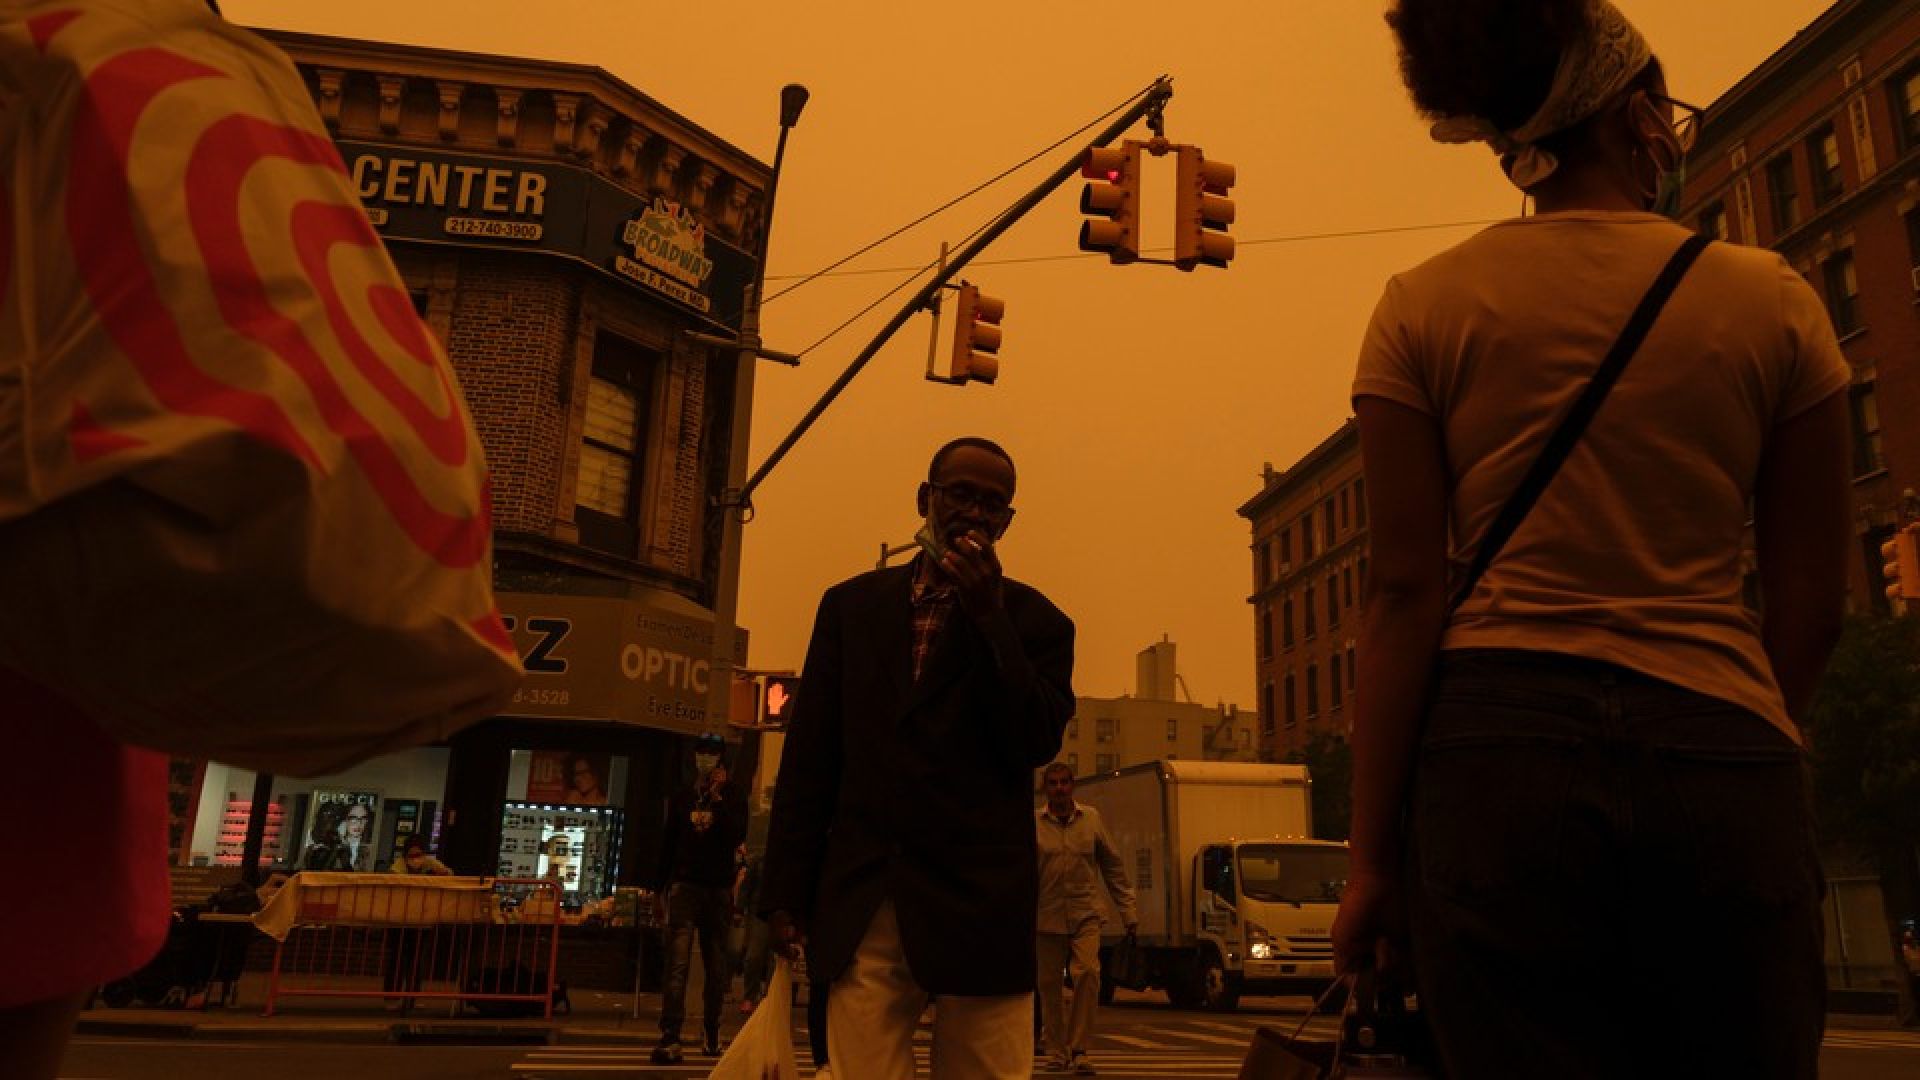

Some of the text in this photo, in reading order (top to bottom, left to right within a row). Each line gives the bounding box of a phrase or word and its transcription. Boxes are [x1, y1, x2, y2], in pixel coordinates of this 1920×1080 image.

[353, 154, 547, 215] CENTER
[450, 219, 538, 238] 212-740-3900
[625, 222, 711, 278] BROADWAY
[621, 643, 709, 695] OPTIC
[648, 695, 671, 717] Eye
[318, 793, 375, 806] GUCCI
